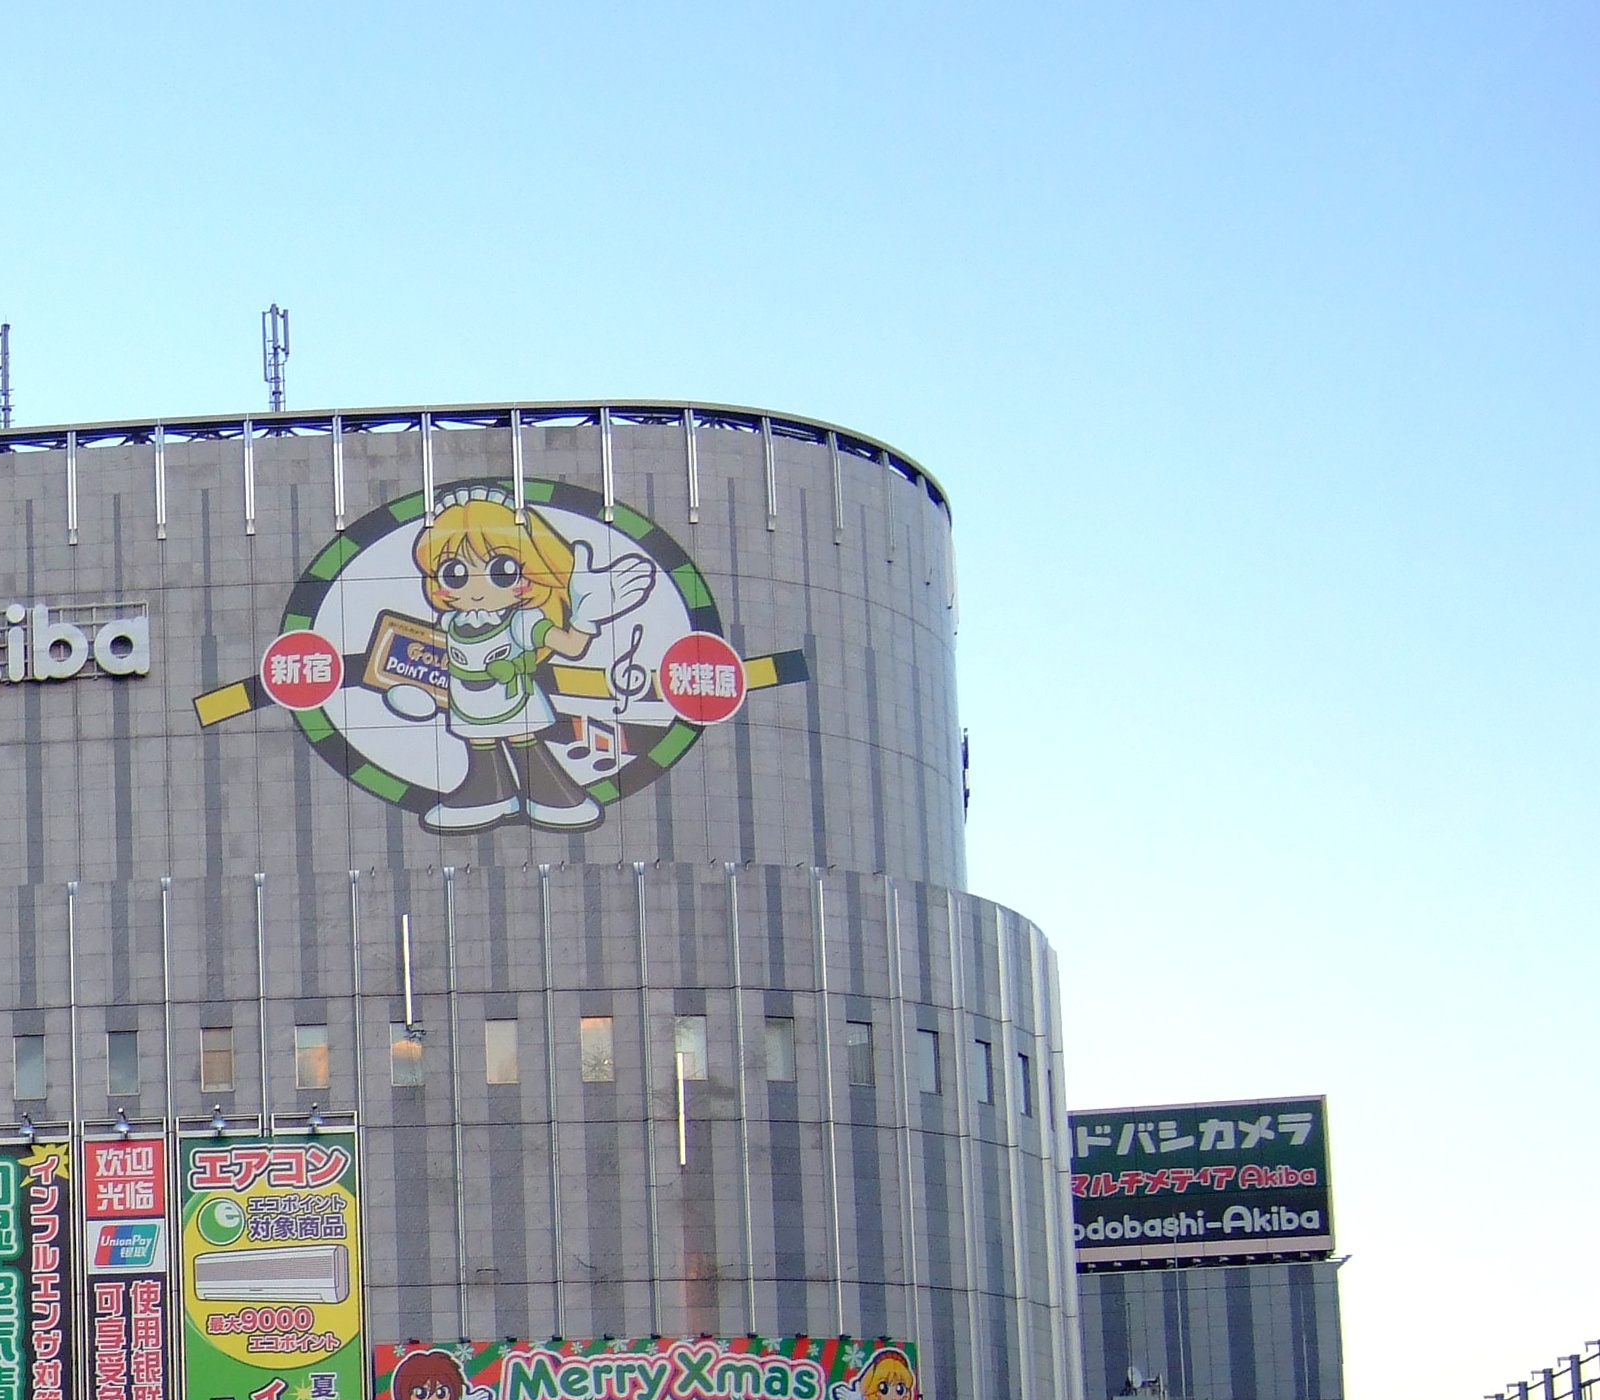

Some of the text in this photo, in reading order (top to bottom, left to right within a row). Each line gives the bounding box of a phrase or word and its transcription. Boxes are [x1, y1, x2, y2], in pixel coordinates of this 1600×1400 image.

[270, 652, 332, 685] 新宿
[386, 656, 450, 689] POINT CA
[669, 661, 738, 698] 秋葉原
[1069, 1112, 1314, 1157] ドバシカメラ
[95, 1147, 154, 1177] 欢迎
[190, 1145, 350, 1194] エアコン
[1239, 1164, 1317, 1188] Akiba
[96, 1180, 154, 1211] 光临
[248, 1195, 347, 1214] エコポイント
[248, 1215, 347, 1240] 対象商品
[1071, 1205, 1321, 1242] odobashi-Akiba
[100, 1235, 153, 1251] UnionPay
[249, 1334, 341, 1353] エコポイント
